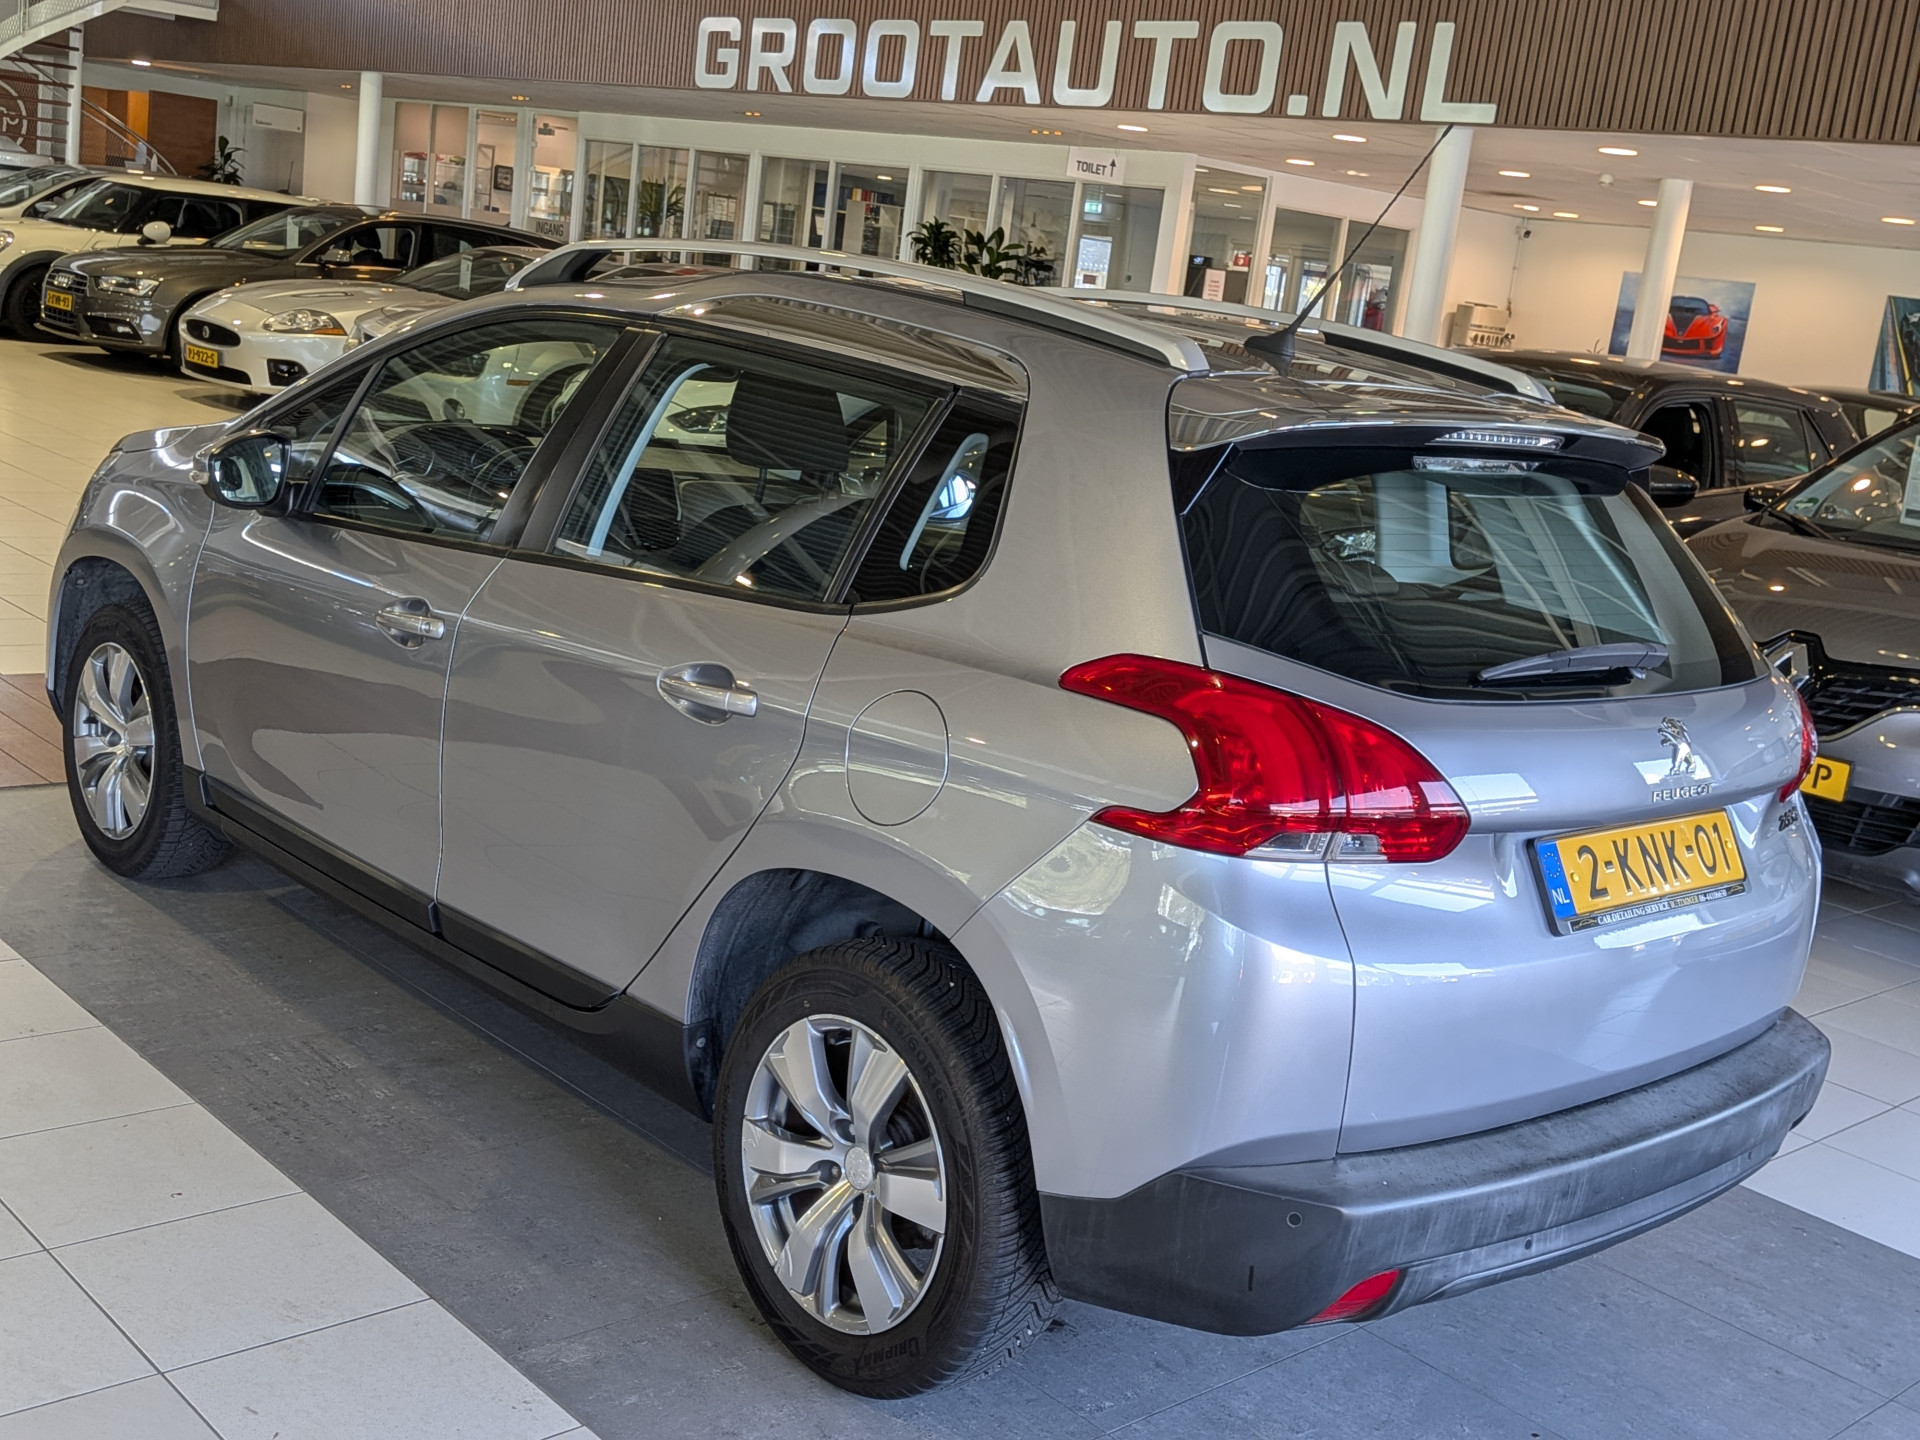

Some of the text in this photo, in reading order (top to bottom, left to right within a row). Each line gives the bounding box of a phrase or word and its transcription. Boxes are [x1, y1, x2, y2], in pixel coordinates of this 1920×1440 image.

[695, 17, 1498, 123] GROOTAUTO.NL
[1076, 160, 1107, 175] TOILET
[536, 221, 564, 237] INGANG
[1652, 783, 1713, 802] PEUGEOT
[1576, 822, 1731, 900] 2-KNK-01
[1551, 889, 1571, 905] NL
[1597, 913, 1611, 925] CAR
[1611, 907, 1646, 923] DETAILING
[1645, 901, 1670, 915] SERVICE
